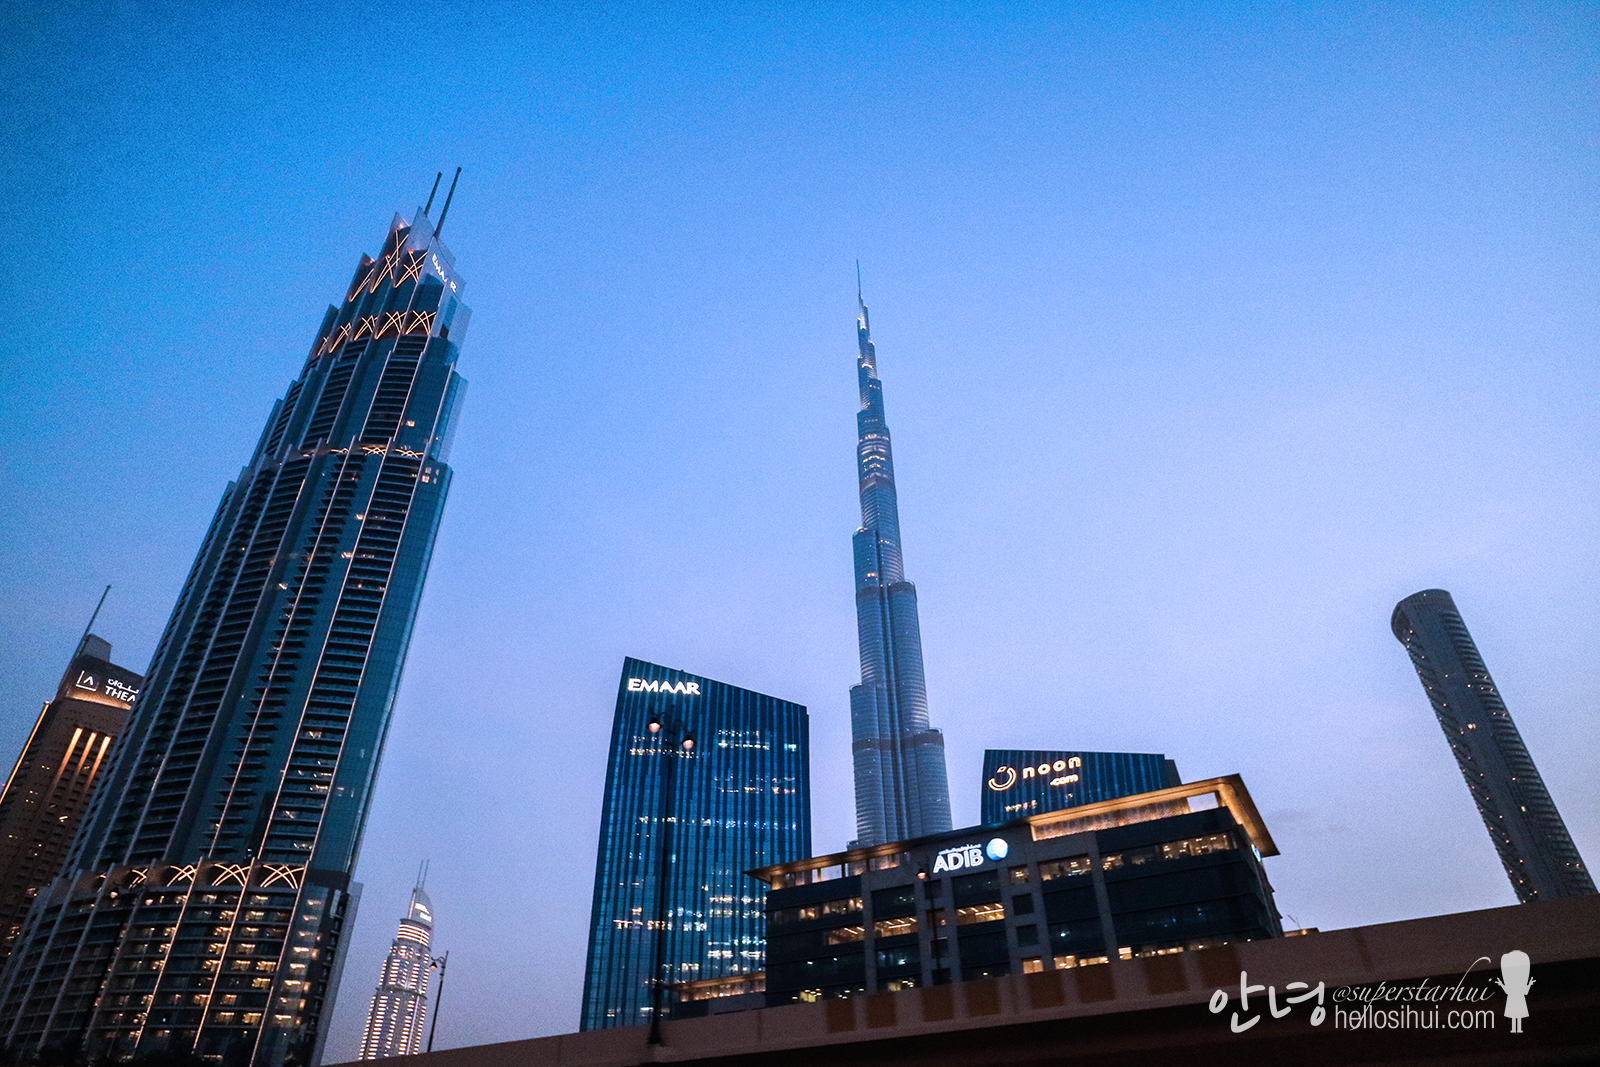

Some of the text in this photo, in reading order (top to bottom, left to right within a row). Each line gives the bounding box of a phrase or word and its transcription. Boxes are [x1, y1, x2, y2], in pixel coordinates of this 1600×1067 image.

[627, 678, 701, 695] EMAAR
[1022, 756, 1082, 779] noon
[1050, 774, 1079, 786] .com
[932, 848, 984, 873] ADIB
